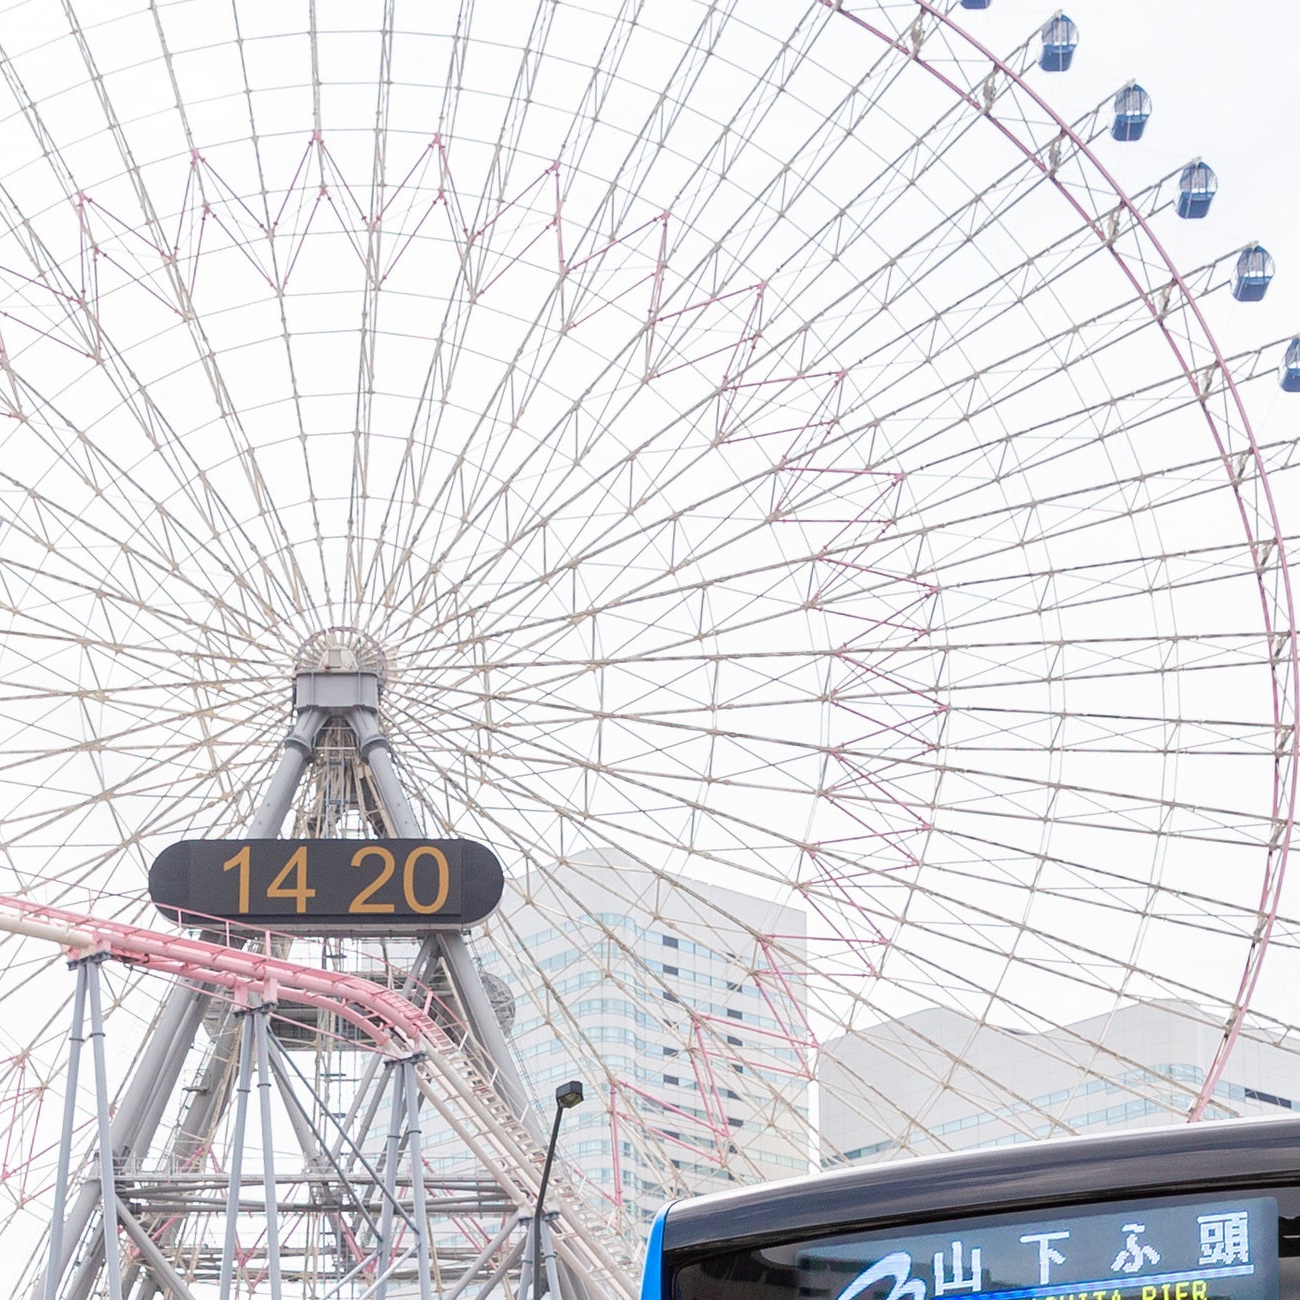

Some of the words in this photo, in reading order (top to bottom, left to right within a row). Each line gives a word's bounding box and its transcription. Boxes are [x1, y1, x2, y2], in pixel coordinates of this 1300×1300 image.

[222, 846, 316, 914] 14
[348, 846, 450, 914] 20
[933, 1211, 1249, 1296] 山下ふ頭
